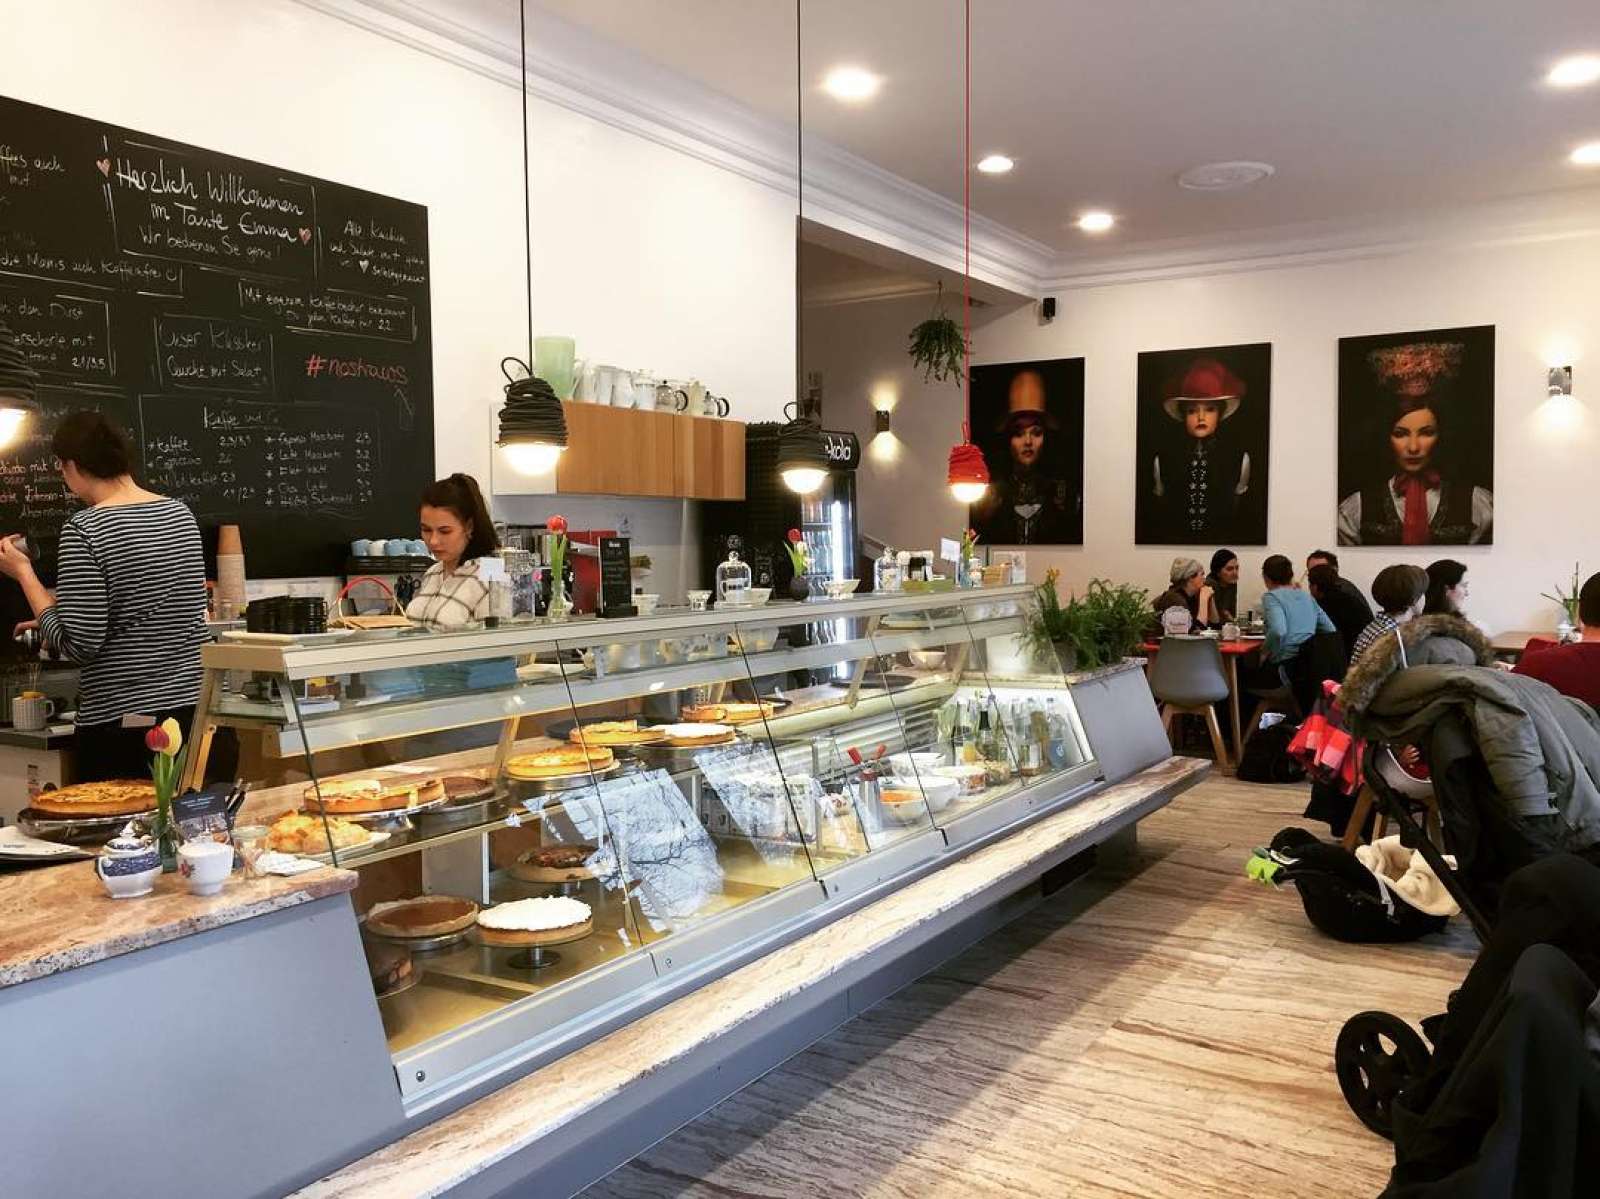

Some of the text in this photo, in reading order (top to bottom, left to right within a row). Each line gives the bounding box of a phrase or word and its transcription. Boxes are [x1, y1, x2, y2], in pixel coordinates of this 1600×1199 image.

[115, 157, 304, 216] Herzlich Willkommen
[173, 201, 229, 230] Tante
[237, 211, 298, 243] Emma
